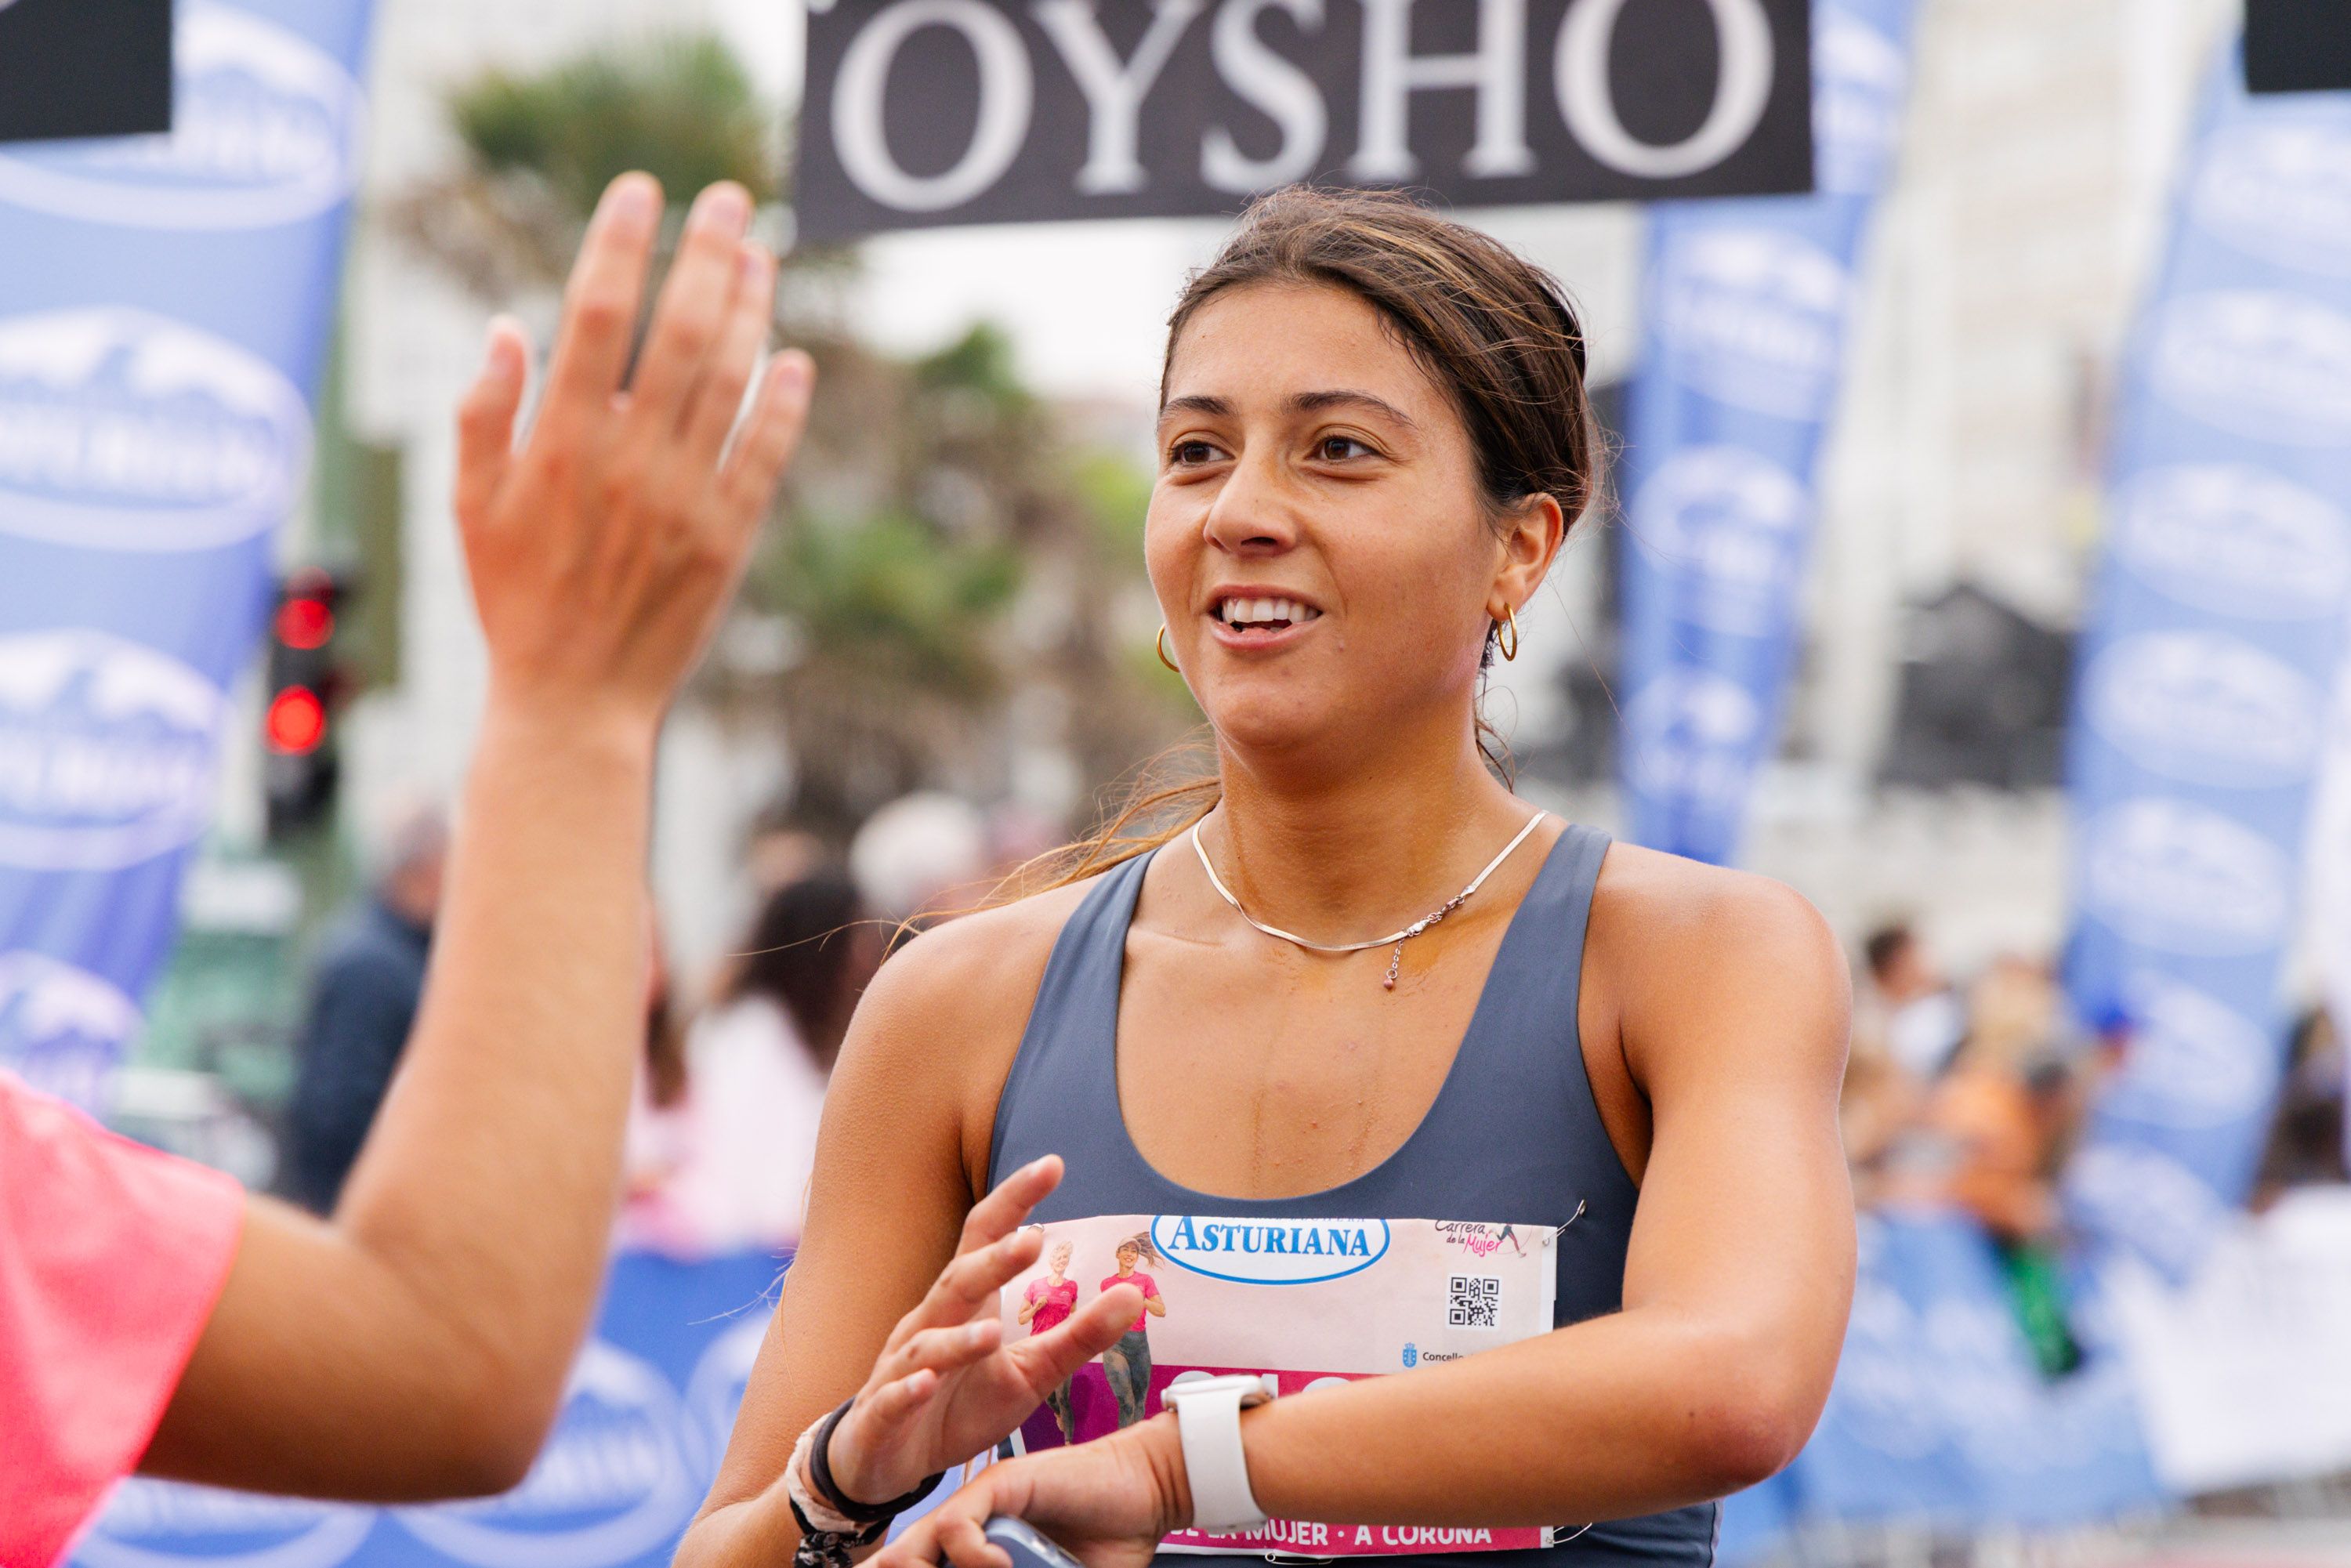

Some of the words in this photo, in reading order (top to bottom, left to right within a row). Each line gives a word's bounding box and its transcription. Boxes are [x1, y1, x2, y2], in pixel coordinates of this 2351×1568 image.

[831, 0, 1776, 211] OYSHO
[1435, 1219, 1485, 1234] Carrera
[1446, 1233, 1457, 1244] de
[1458, 1233, 1465, 1244] la
[1462, 1233, 1503, 1257] Mujer
